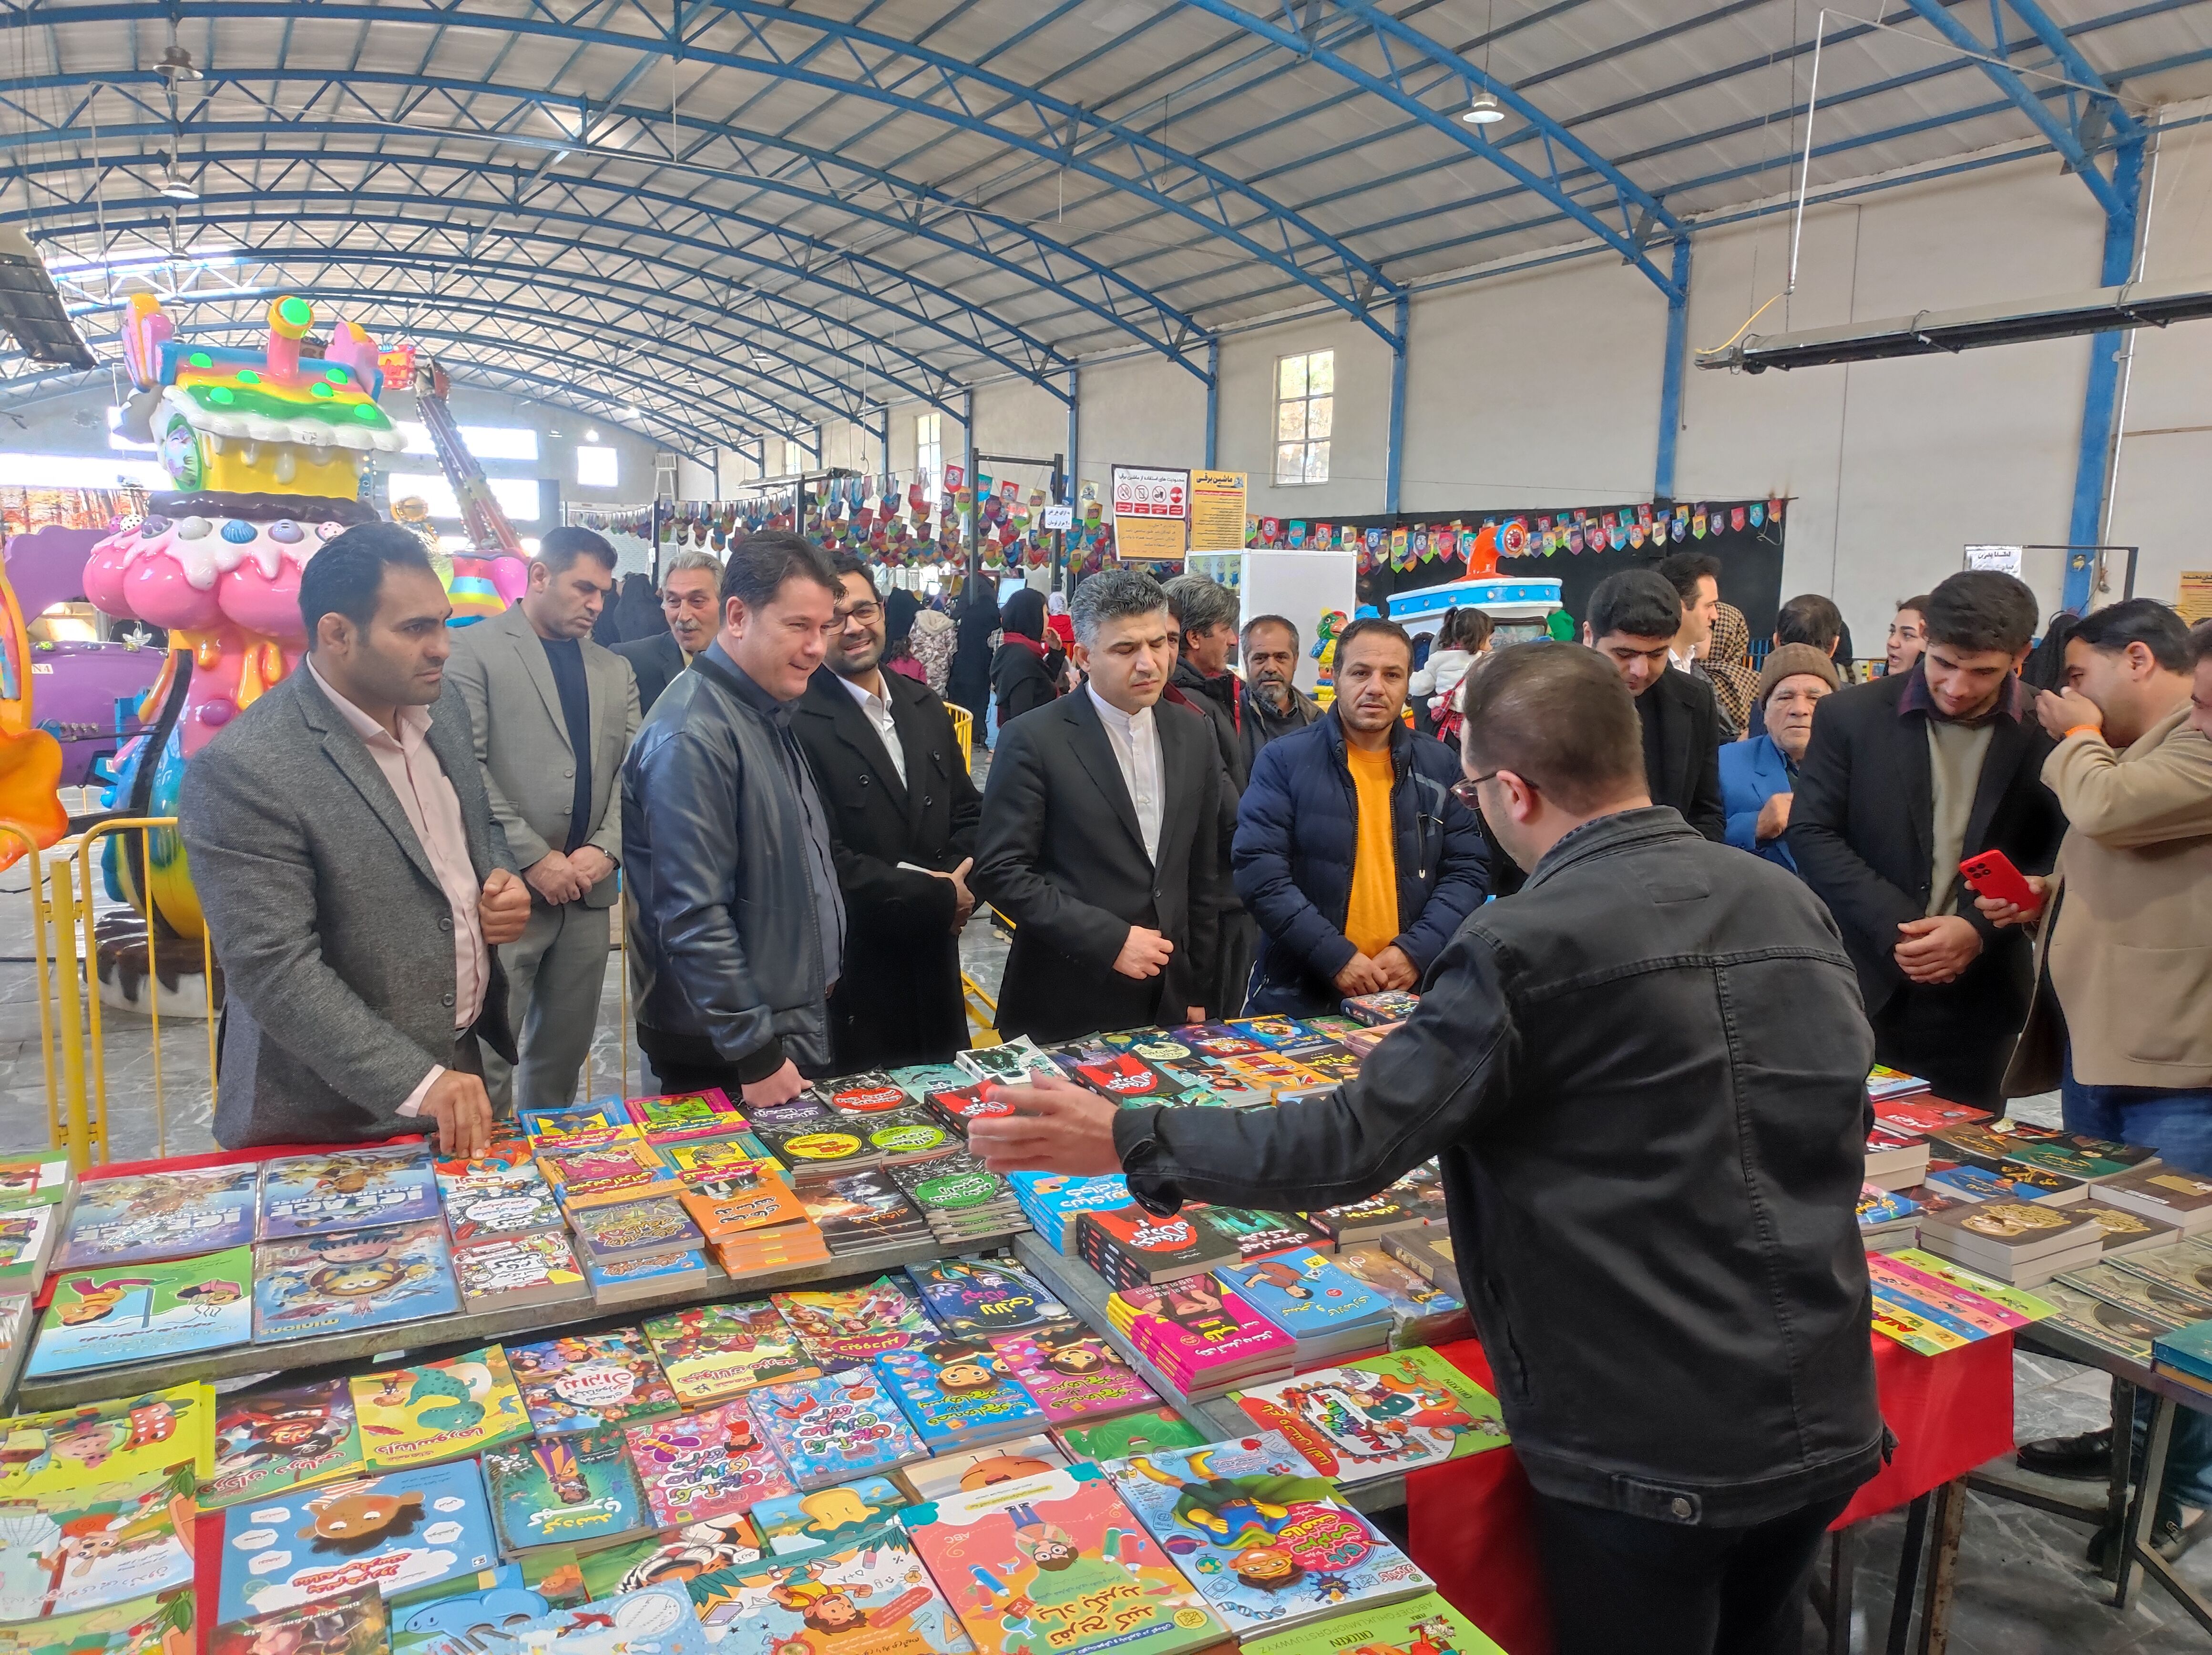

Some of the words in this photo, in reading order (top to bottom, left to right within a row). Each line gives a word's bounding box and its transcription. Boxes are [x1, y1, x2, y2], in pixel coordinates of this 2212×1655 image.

[1196, 472, 1212, 483] برقی
[1213, 474, 1232, 483] ماشین
[270, 1198, 348, 1217] AGE
[356, 1190, 423, 1207] ICE
[167, 1211, 241, 1231] ICE
[1239, 1232, 1310, 1253] تیمارستان
[257, 1318, 340, 1335] minions
[1203, 1324, 1240, 1343] قلب
[1241, 1320, 1260, 1329] است
[1194, 1347, 1217, 1357] رنگ
[1216, 1338, 1242, 1354] آسمان
[1251, 1330, 1273, 1342] شکل
[677, 1365, 748, 1384] حیوانات
[747, 1357, 799, 1370] مزرعه
[1098, 1374, 1132, 1387] خوب
[1443, 1377, 1473, 1399] CHICKEN
[983, 1388, 1018, 1400] خوب
[1110, 1387, 1145, 1399] خوب
[990, 1401, 1027, 1414] خوب
[1260, 1404, 1282, 1424] باغ
[1317, 1413, 1345, 1439] ZOO
[375, 1427, 485, 1454] دایناسورها
[542, 1512, 613, 1536] گردنبند
[1280, 1513, 1336, 1536] خلاقیت
[944, 1531, 970, 1543] ABC
[1036, 1603, 1075, 1621] یاد
[1082, 1584, 1141, 1613] بگیرید
[1049, 1615, 1109, 1646] تفریح
[1114, 1605, 1153, 1631] کنید
[1329, 1630, 1374, 1648] CHICKEN
